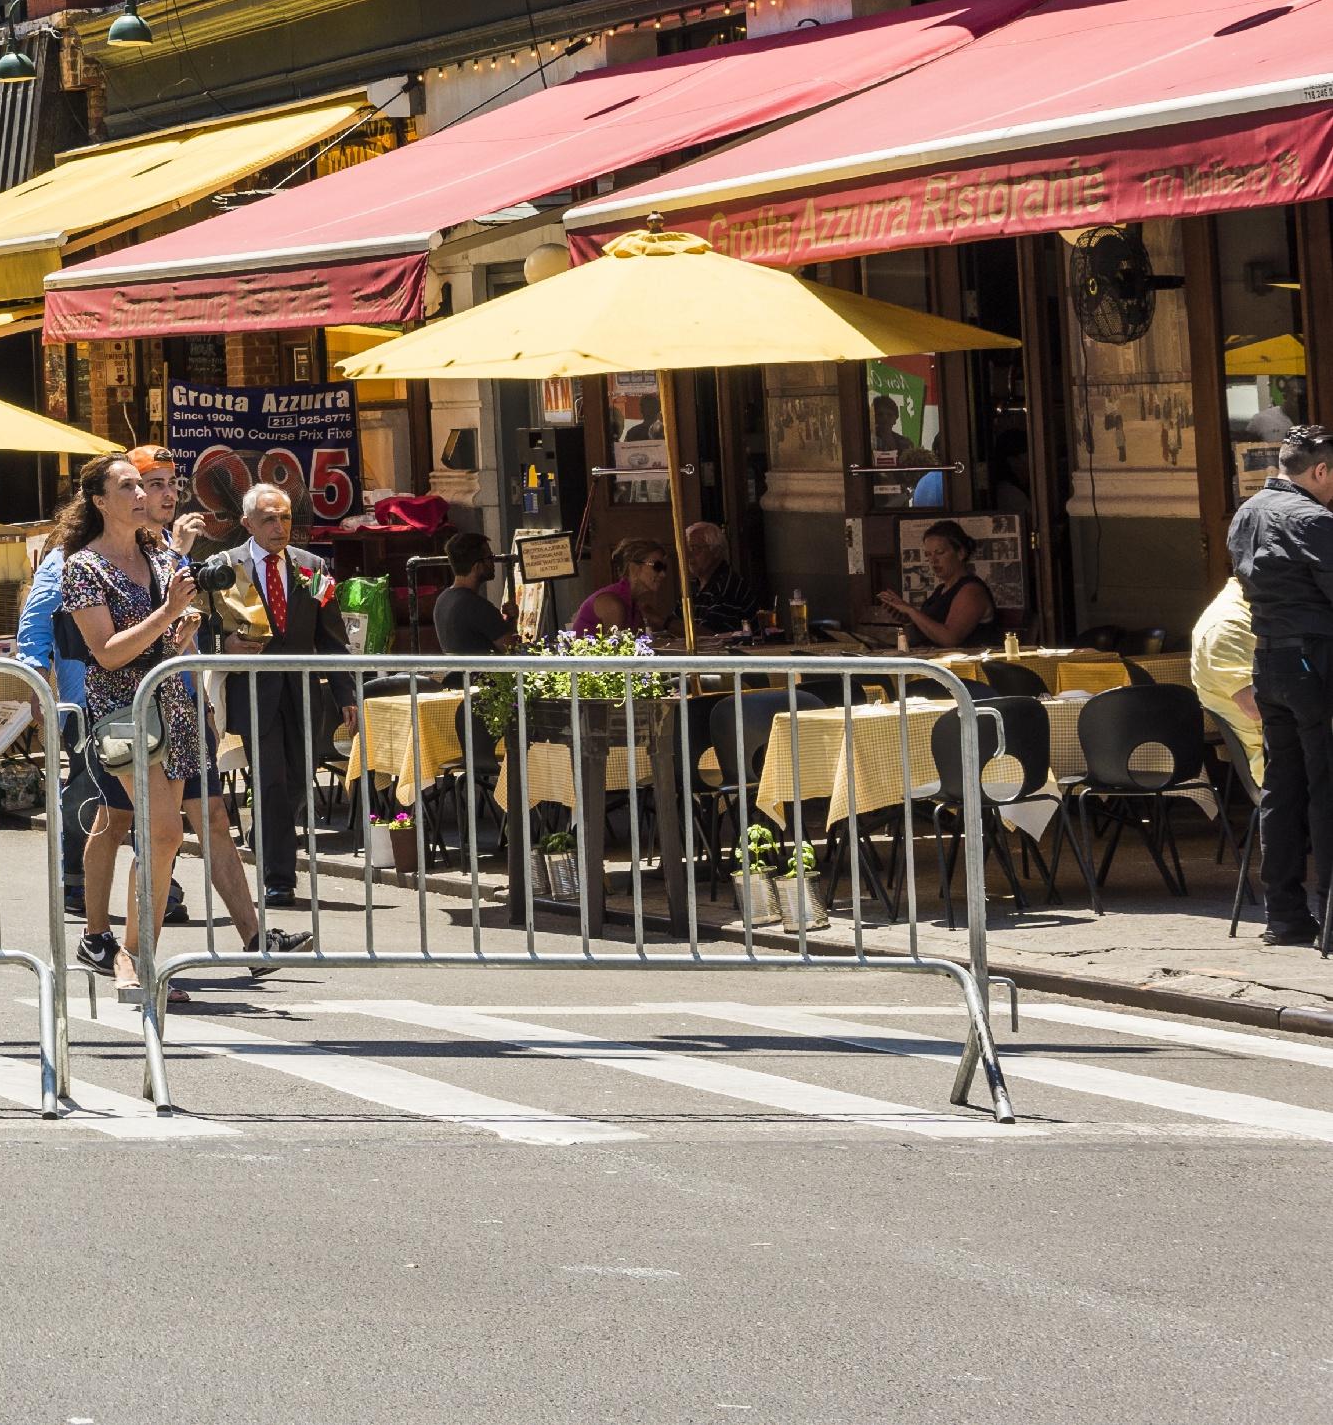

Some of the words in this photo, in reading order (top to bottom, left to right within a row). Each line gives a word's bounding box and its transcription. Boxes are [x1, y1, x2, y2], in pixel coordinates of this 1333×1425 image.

[706, 204, 793, 257] Grotta
[794, 197, 912, 252] Azzurra
[919, 158, 1104, 234] Ristorante
[172, 385, 249, 413] Grotta
[262, 389, 350, 414] Azzurra
[544, 378, 571, 411] ATM
[172, 411, 204, 421] Since
[206, 413, 234, 423] 1908
[272, 416, 294, 426] 212
[299, 413, 351, 426] 925-8775
[172, 426, 212, 438] Lunch
[213, 426, 245, 439] TWO
[248, 428, 296, 442] Course
[299, 428, 323, 441] Prix
[327, 426, 353, 440] Fixe
[172, 448, 197, 459] Mon
[175, 463, 186, 473] Fri
